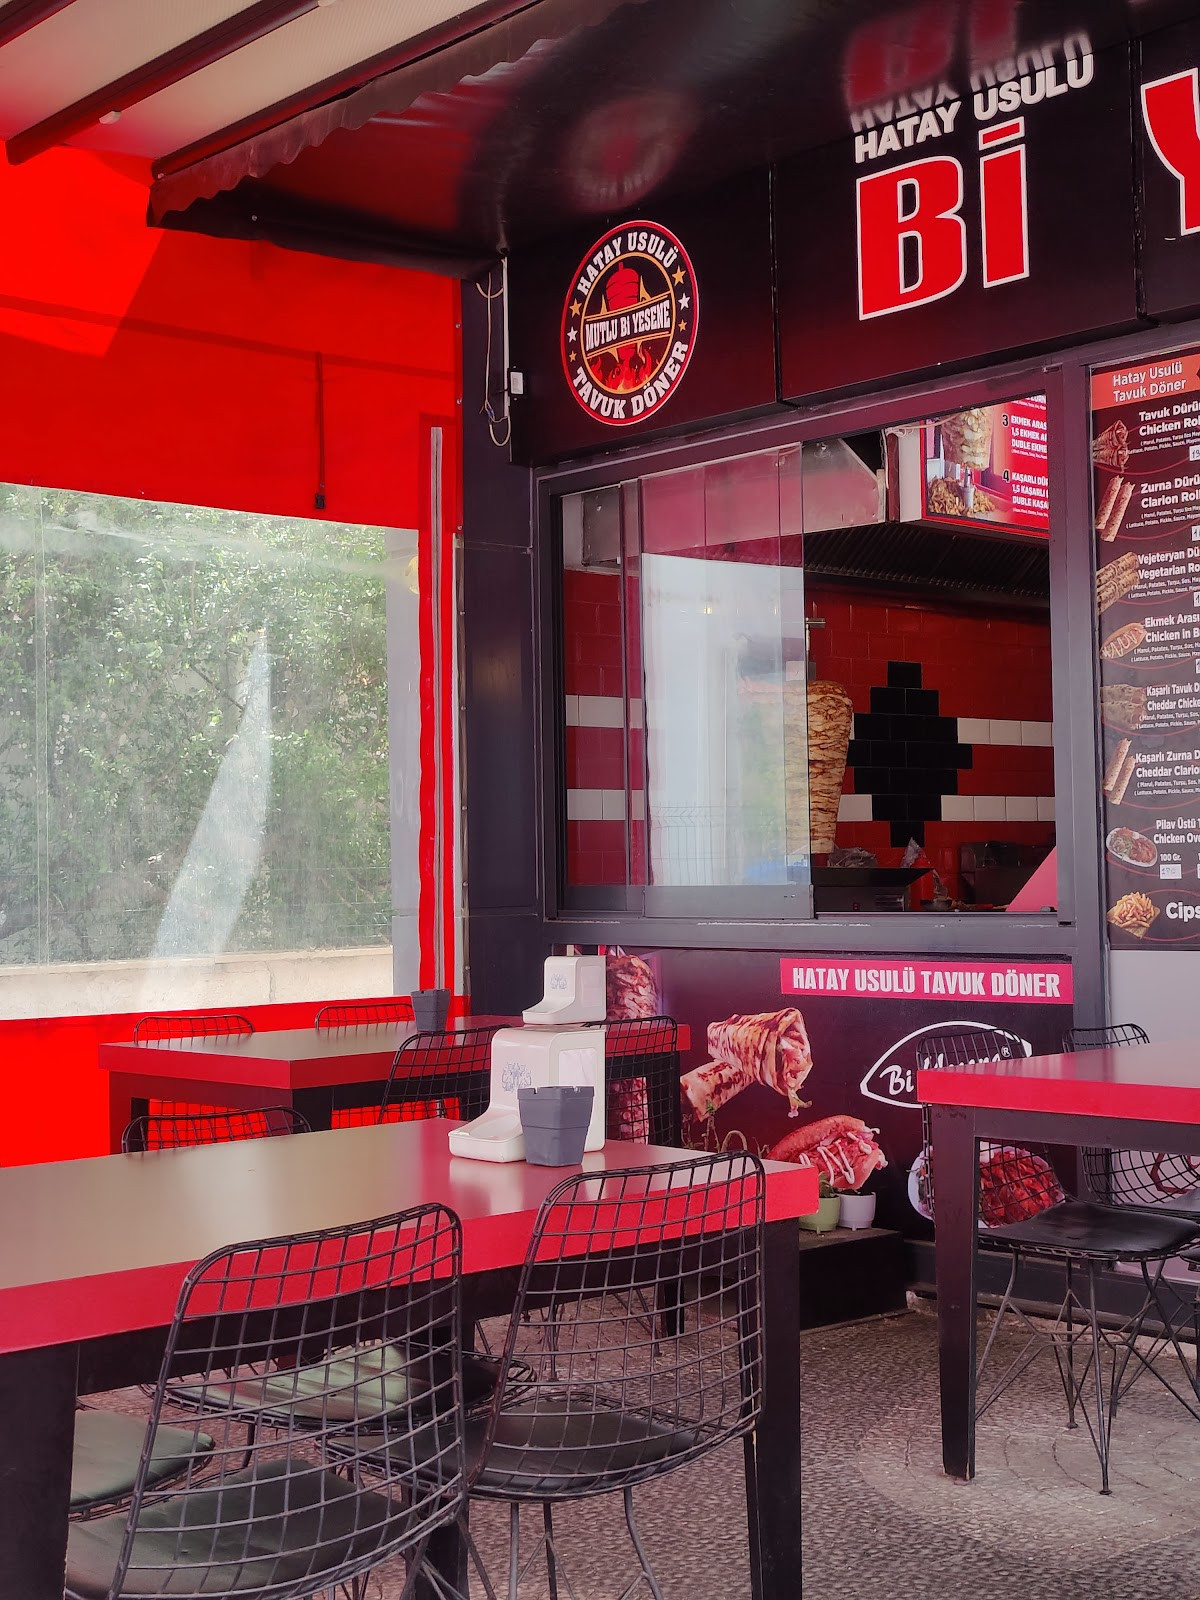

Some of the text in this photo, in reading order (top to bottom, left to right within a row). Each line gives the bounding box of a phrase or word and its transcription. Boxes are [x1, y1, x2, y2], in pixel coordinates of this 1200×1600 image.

[855, 101, 961, 164] HATAY
[577, 231, 680, 296] HATAY USULÜ
[585, 316, 618, 351] MUTLU
[632, 299, 671, 333] YESENE
[572, 340, 688, 419] TAVUK DÖNER
[1112, 361, 1183, 387] Hatay Usulü
[1113, 379, 1187, 403] Tavuk Döner
[1139, 400, 1200, 421] Tavuk Dürü
[1002, 414, 1009, 427] 3
[1011, 415, 1032, 427] EKMEK
[1020, 429, 1040, 440] EKMEK
[1139, 421, 1181, 436] Chicken
[1003, 469, 1010, 483] 4
[1011, 472, 1037, 484] KAŞARLI
[1021, 486, 1045, 498] KAŞARLI
[1140, 480, 1172, 494] Zurna
[1012, 495, 1032, 507] DUBLE
[1141, 494, 1179, 509] Clarion
[1138, 550, 1185, 566] Vejeteryan
[1138, 564, 1186, 580] Vegetarian
[1144, 613, 1200, 628] Ekmek Arası
[1145, 629, 1180, 643] Chicken
[1182, 628, 1191, 639] in
[1146, 684, 1171, 698] Kaşarlı
[1171, 682, 1193, 694] Tavuk
[1147, 699, 1177, 711] Cheddar
[1135, 751, 1165, 764] Kaşarlı
[1166, 751, 1193, 762] Zurna
[1136, 766, 1172, 778] Cheddar
[1156, 819, 1176, 830] Pilav
[1177, 816, 1197, 829] Üstü
[1153, 832, 1186, 844] Chicken
[1160, 853, 1172, 862] 100
[1165, 901, 1200, 922] Cips
[792, 966, 1061, 998] HATAY USULÜ TAVUK DÖNER
[879, 1064, 915, 1096] Bi
